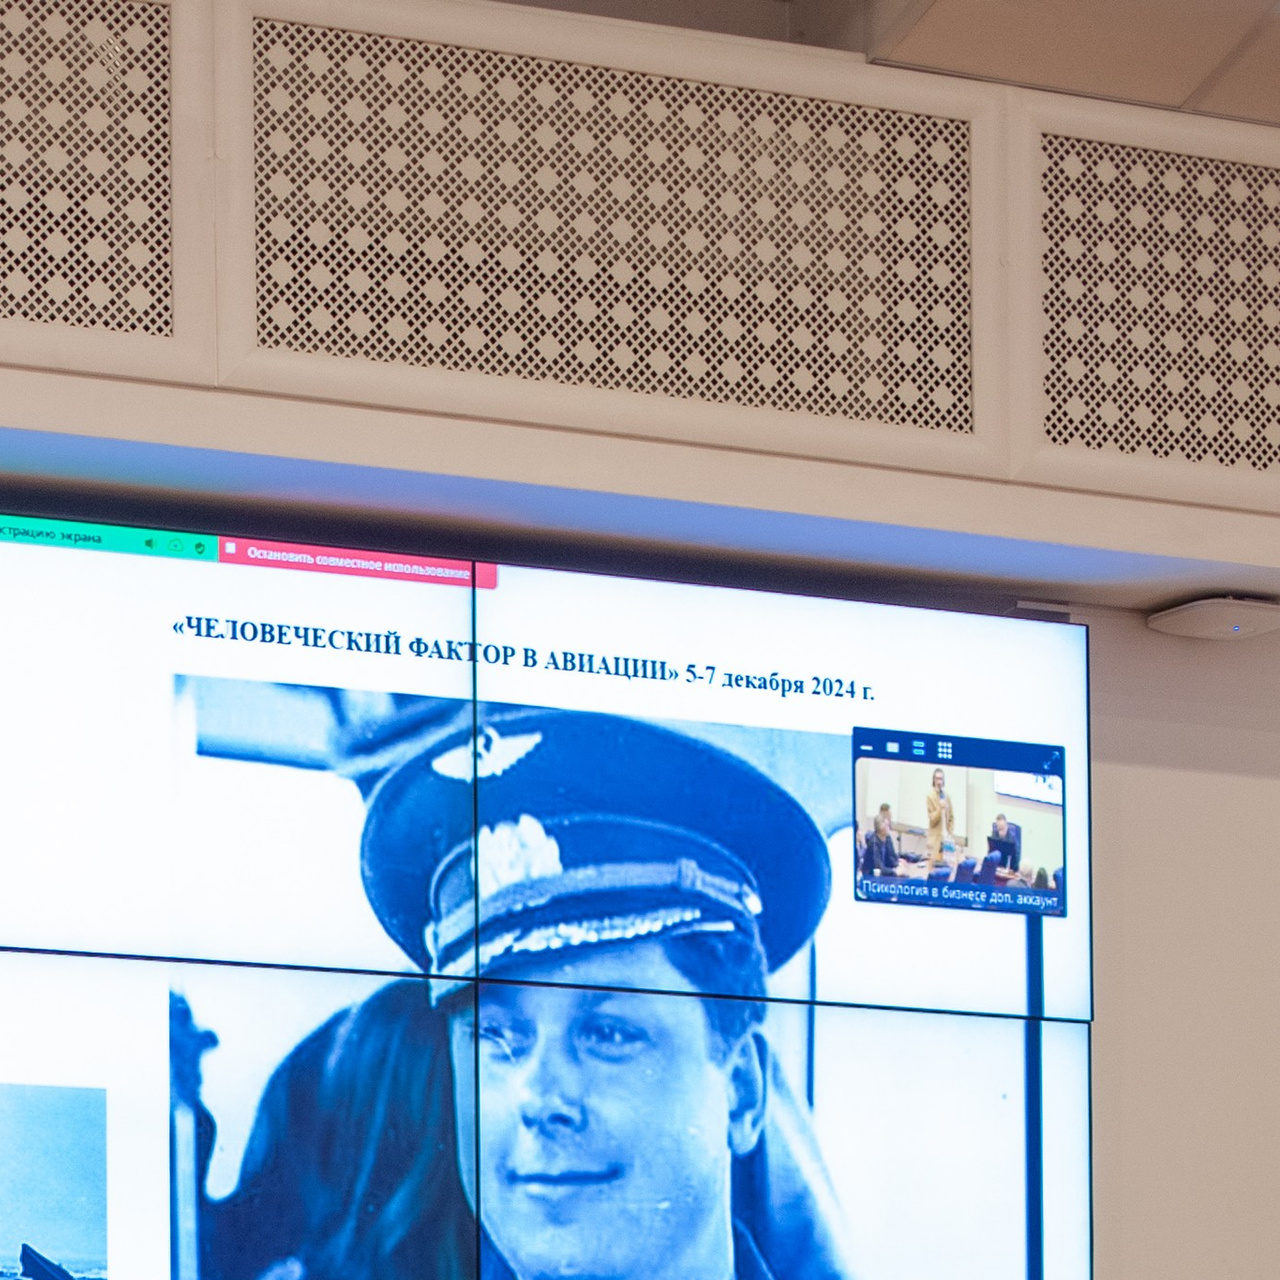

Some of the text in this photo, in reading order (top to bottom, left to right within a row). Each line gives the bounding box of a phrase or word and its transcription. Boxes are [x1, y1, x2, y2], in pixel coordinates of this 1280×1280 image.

[60, 532, 103, 546] экрана
[247, 546, 471, 580] Остановить совместное использование
[172, 615, 877, 700] «ЧЕЛОВЕЧЕСКИЙ ФАКТОР В АВИАЦИИ» 5-7 декабря 2024 г.
[862, 880, 1058, 910] Психология в бизнесе доп. аккаунт
